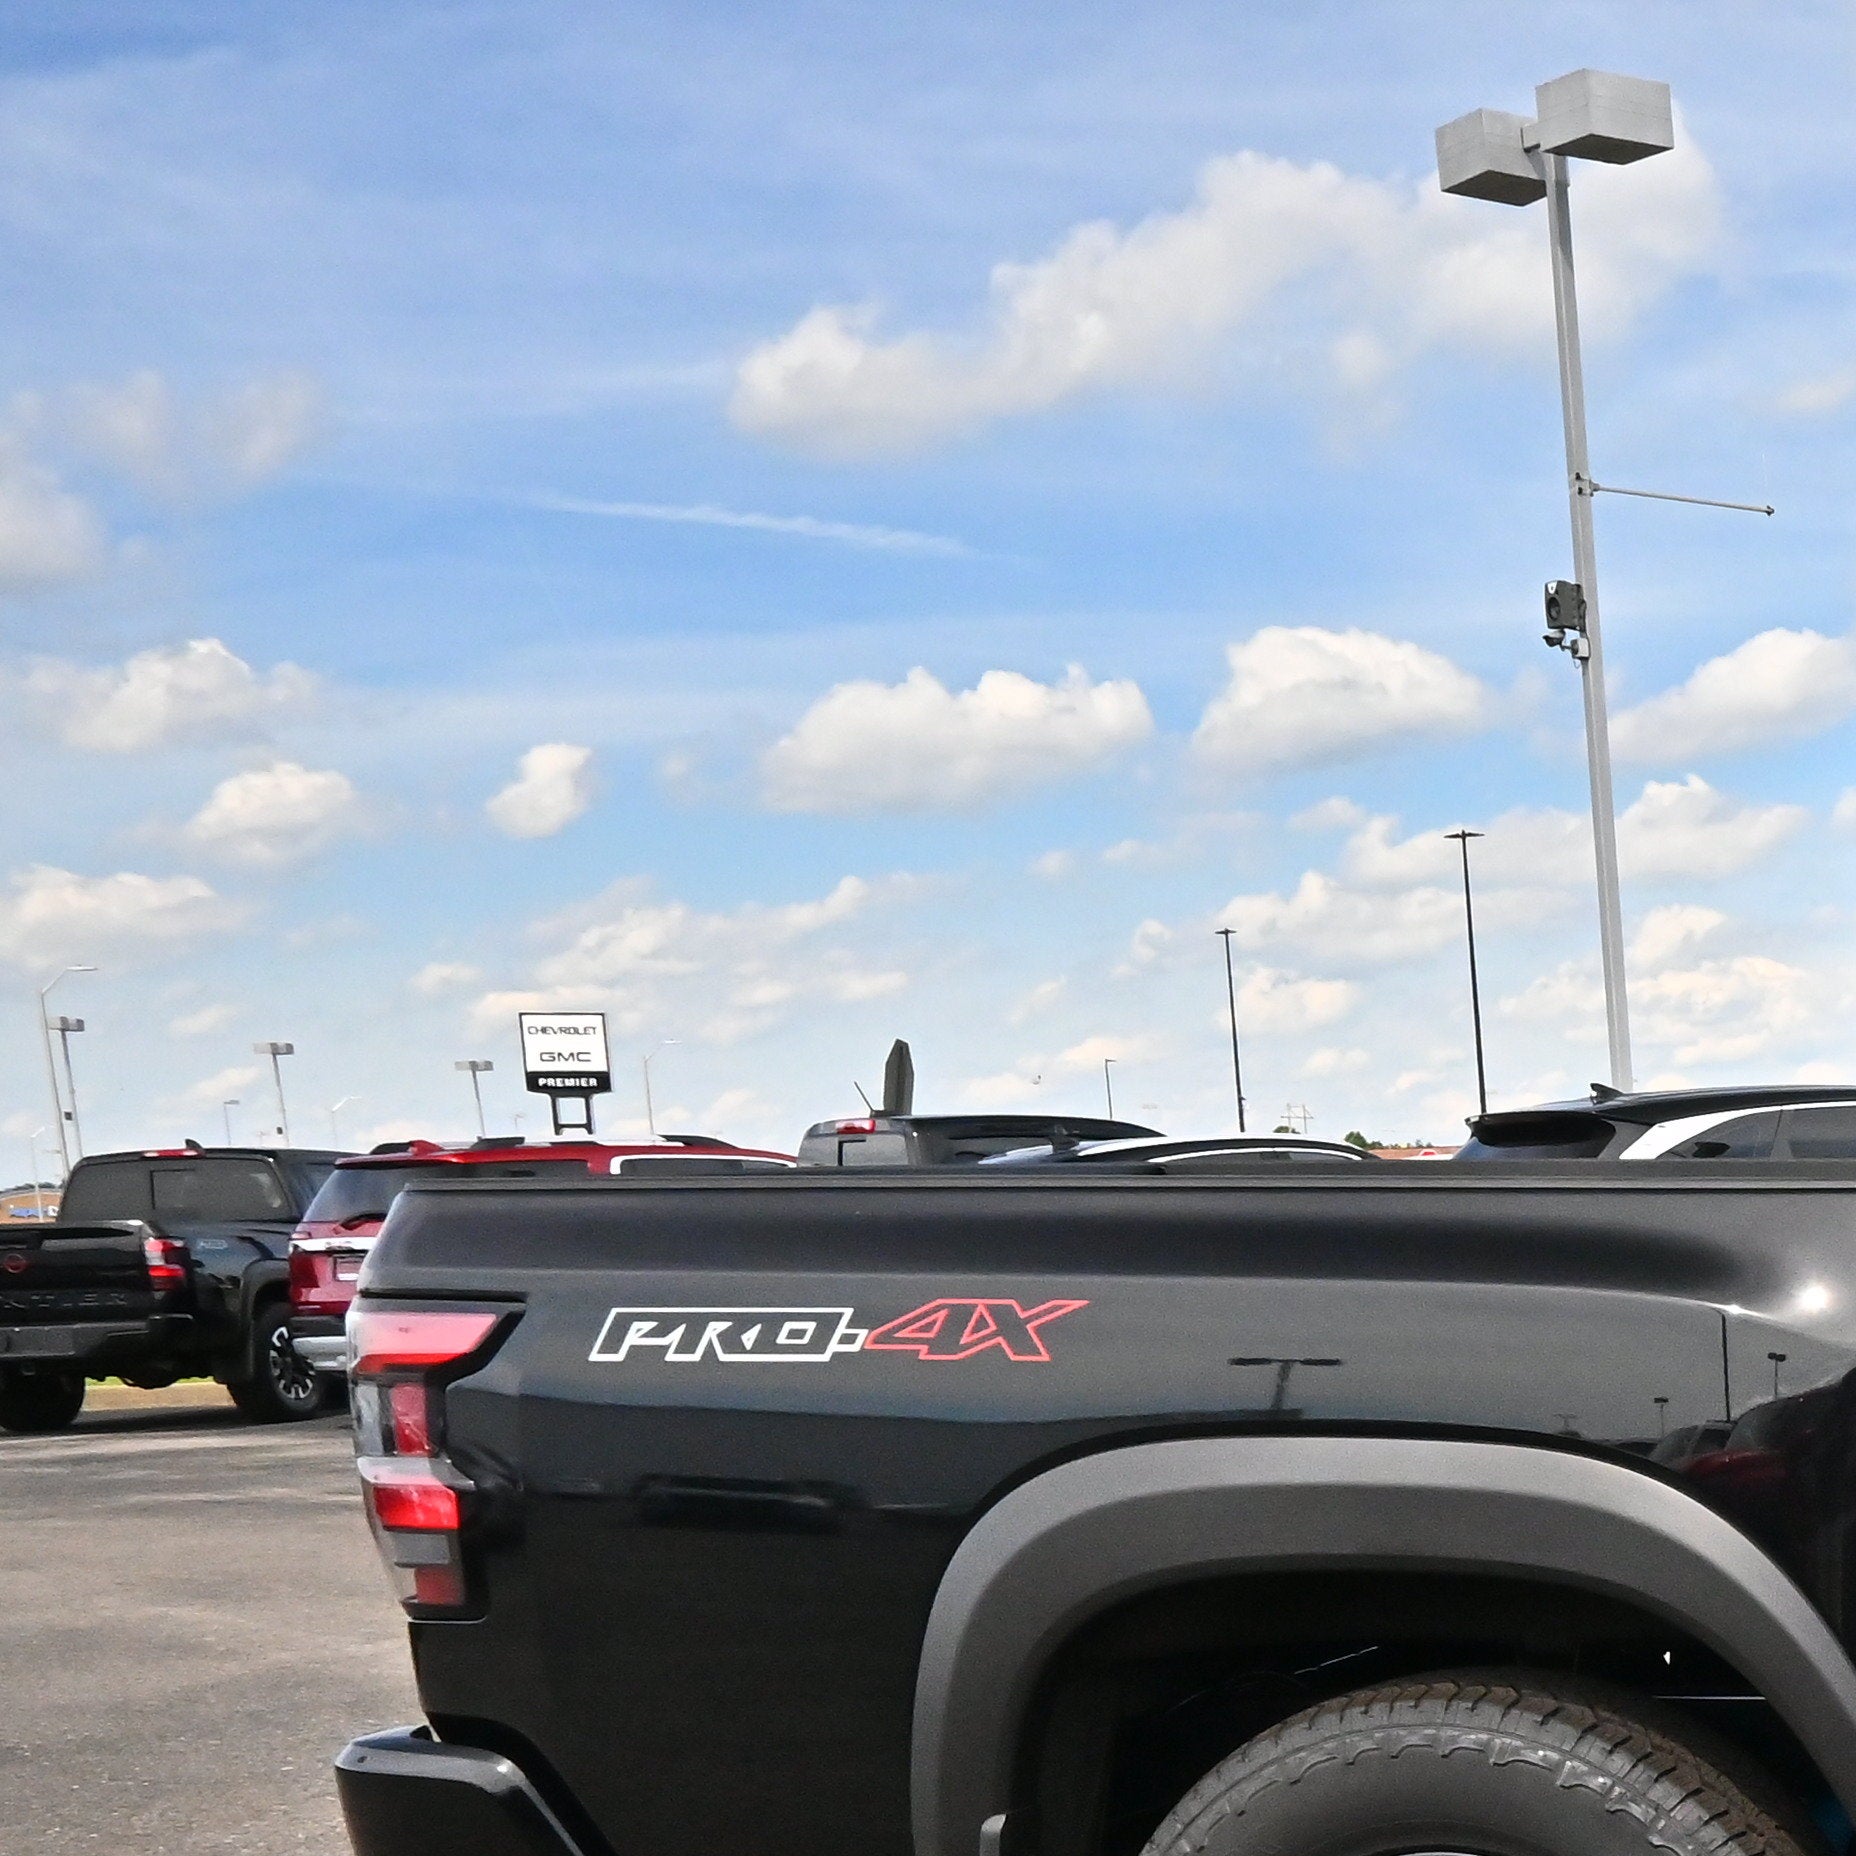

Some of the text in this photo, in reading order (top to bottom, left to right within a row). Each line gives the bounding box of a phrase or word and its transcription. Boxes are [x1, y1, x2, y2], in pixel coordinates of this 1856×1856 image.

[527, 1025, 597, 1036] CHEVROLET
[539, 1051, 592, 1063] GMC
[537, 1077, 598, 1087] PREMIER
